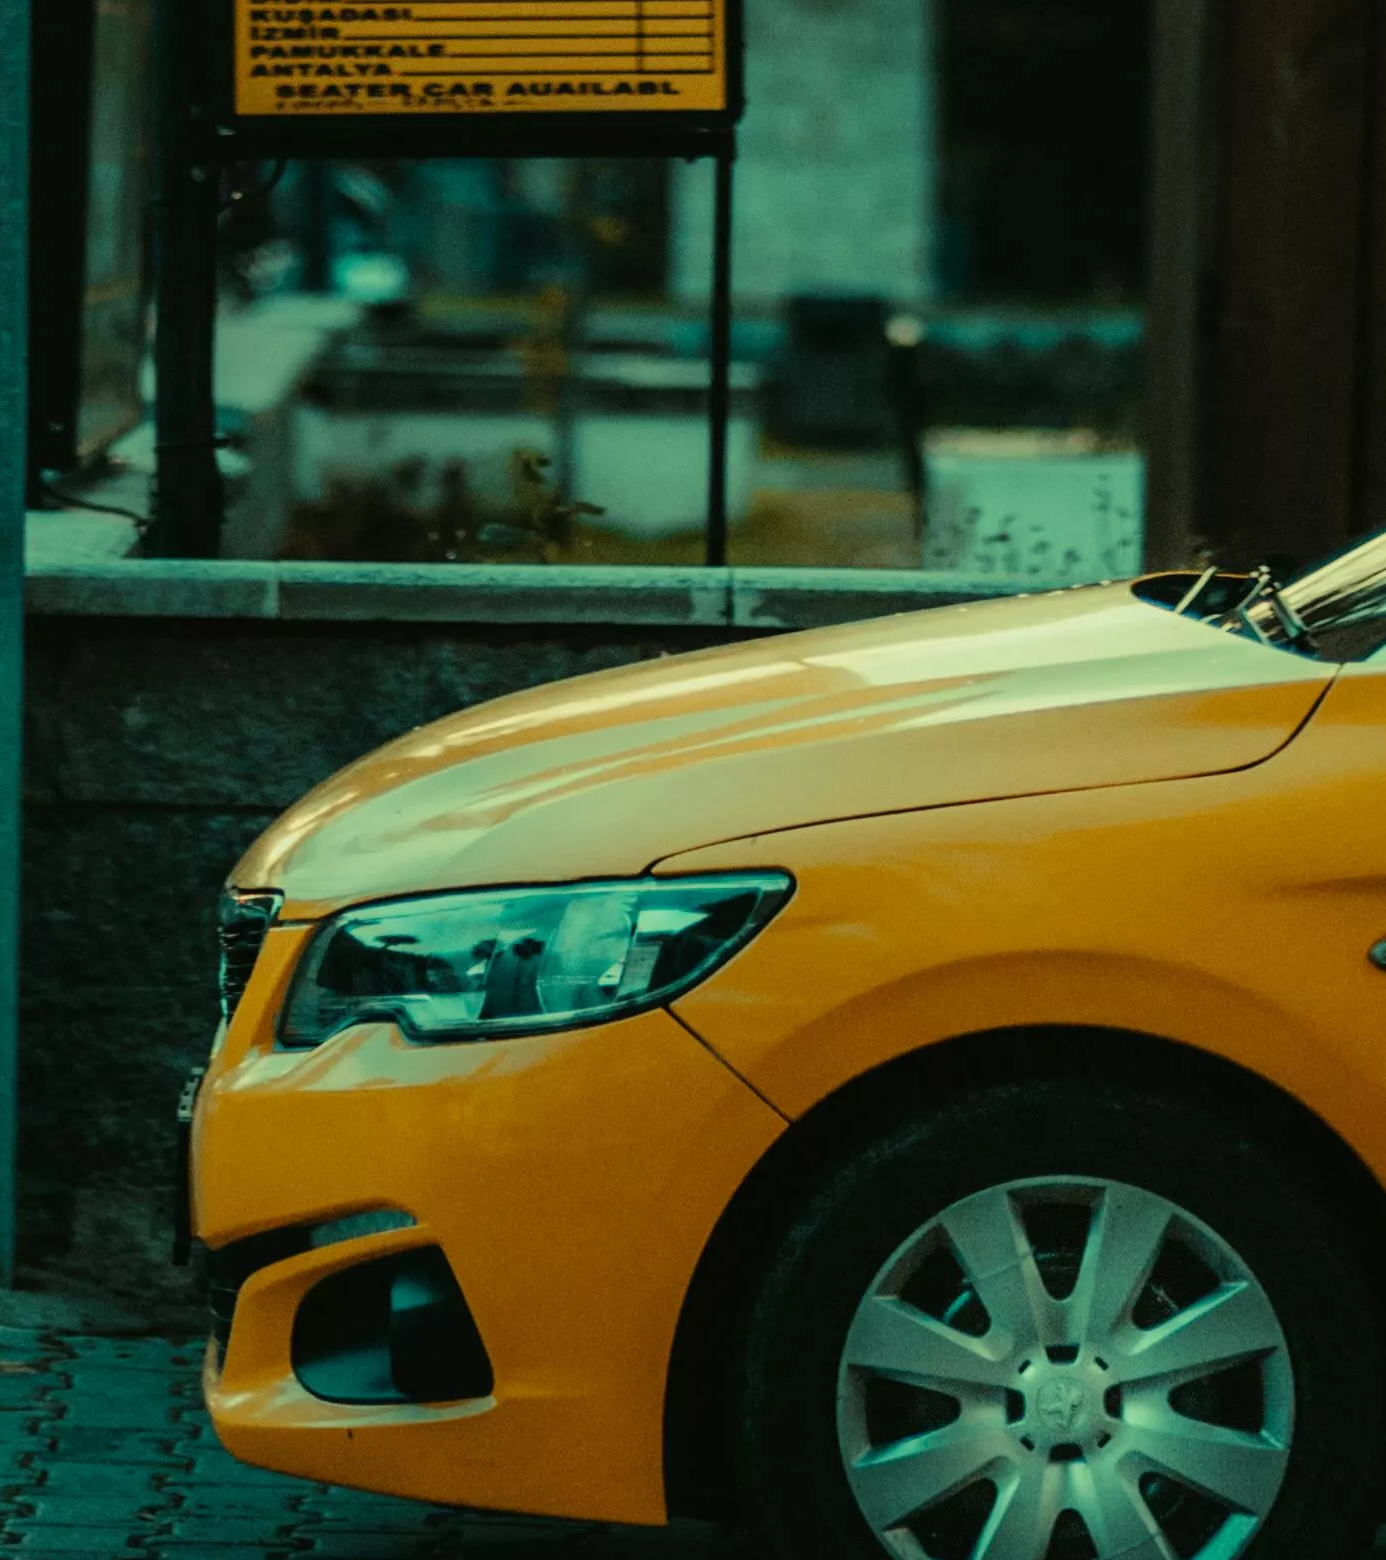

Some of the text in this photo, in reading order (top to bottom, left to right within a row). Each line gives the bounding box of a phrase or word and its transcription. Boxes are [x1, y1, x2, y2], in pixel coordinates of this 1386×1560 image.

[250, 45, 447, 58] PAMUKKALE
[250, 64, 392, 77] ANTALYA
[276, 84, 411, 98] SEATER
[422, 83, 494, 97] CAR
